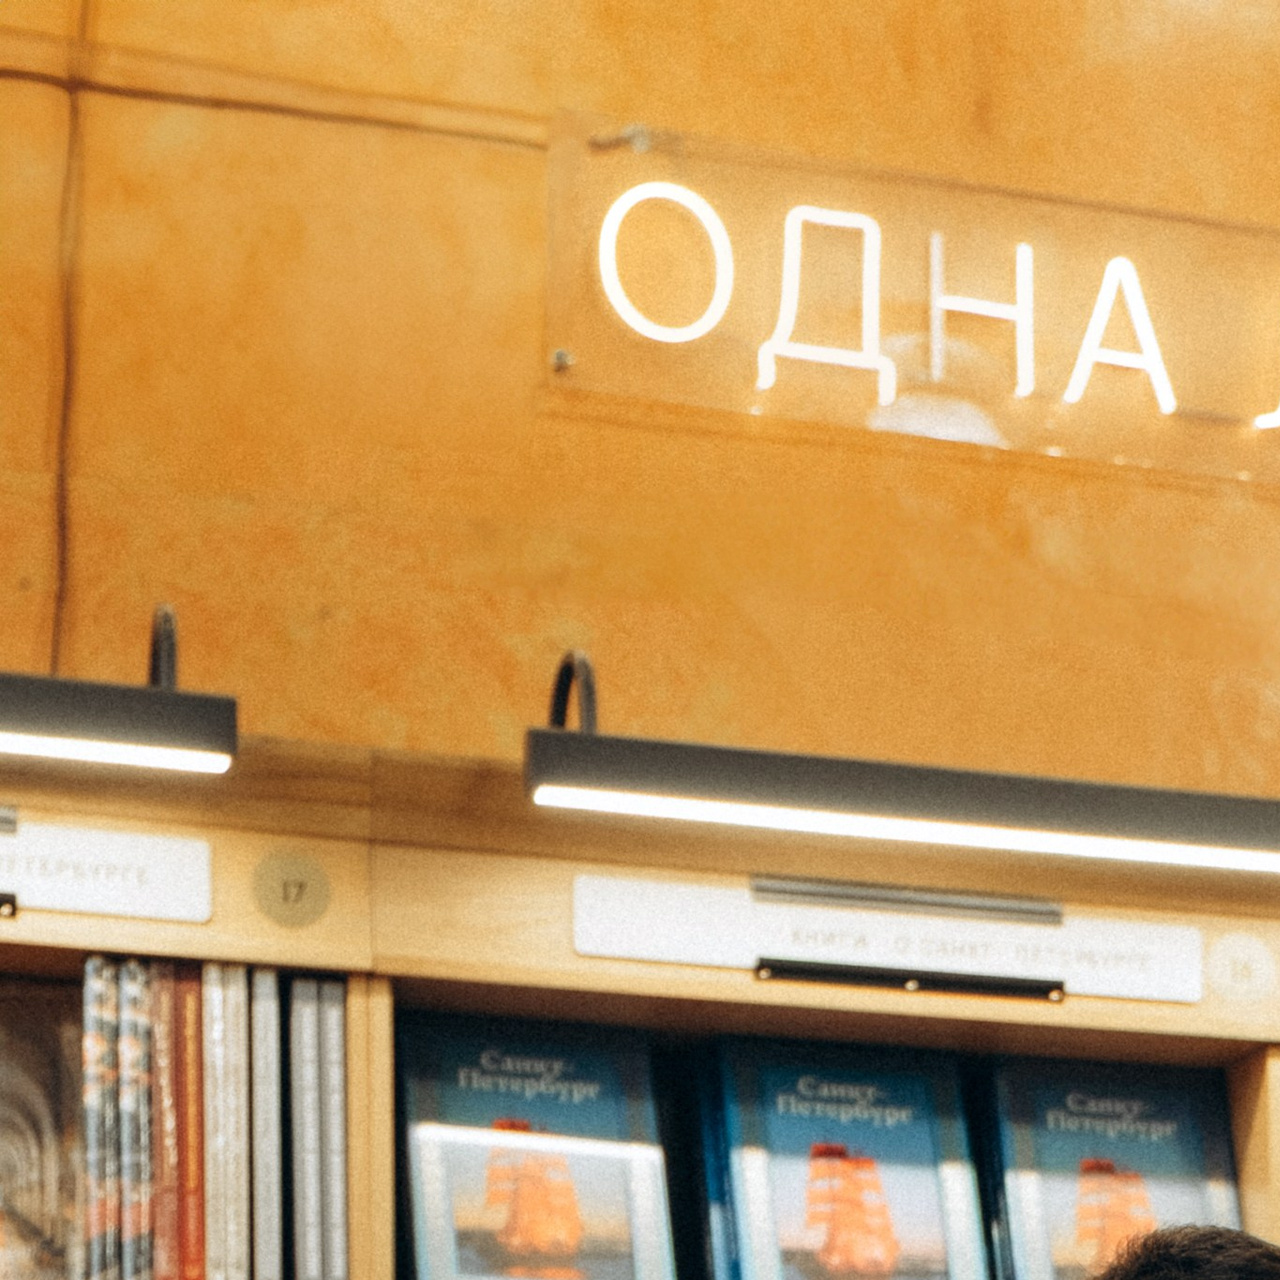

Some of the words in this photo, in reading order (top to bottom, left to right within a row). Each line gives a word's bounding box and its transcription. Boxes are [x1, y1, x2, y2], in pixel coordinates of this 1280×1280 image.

[597, 180, 1177, 410] ОДНА
[281, 880, 307, 904] 17
[457, 1067, 601, 1104] Петербург
[775, 1093, 914, 1128] Петербург
[1045, 1108, 1178, 1142] Петербург
